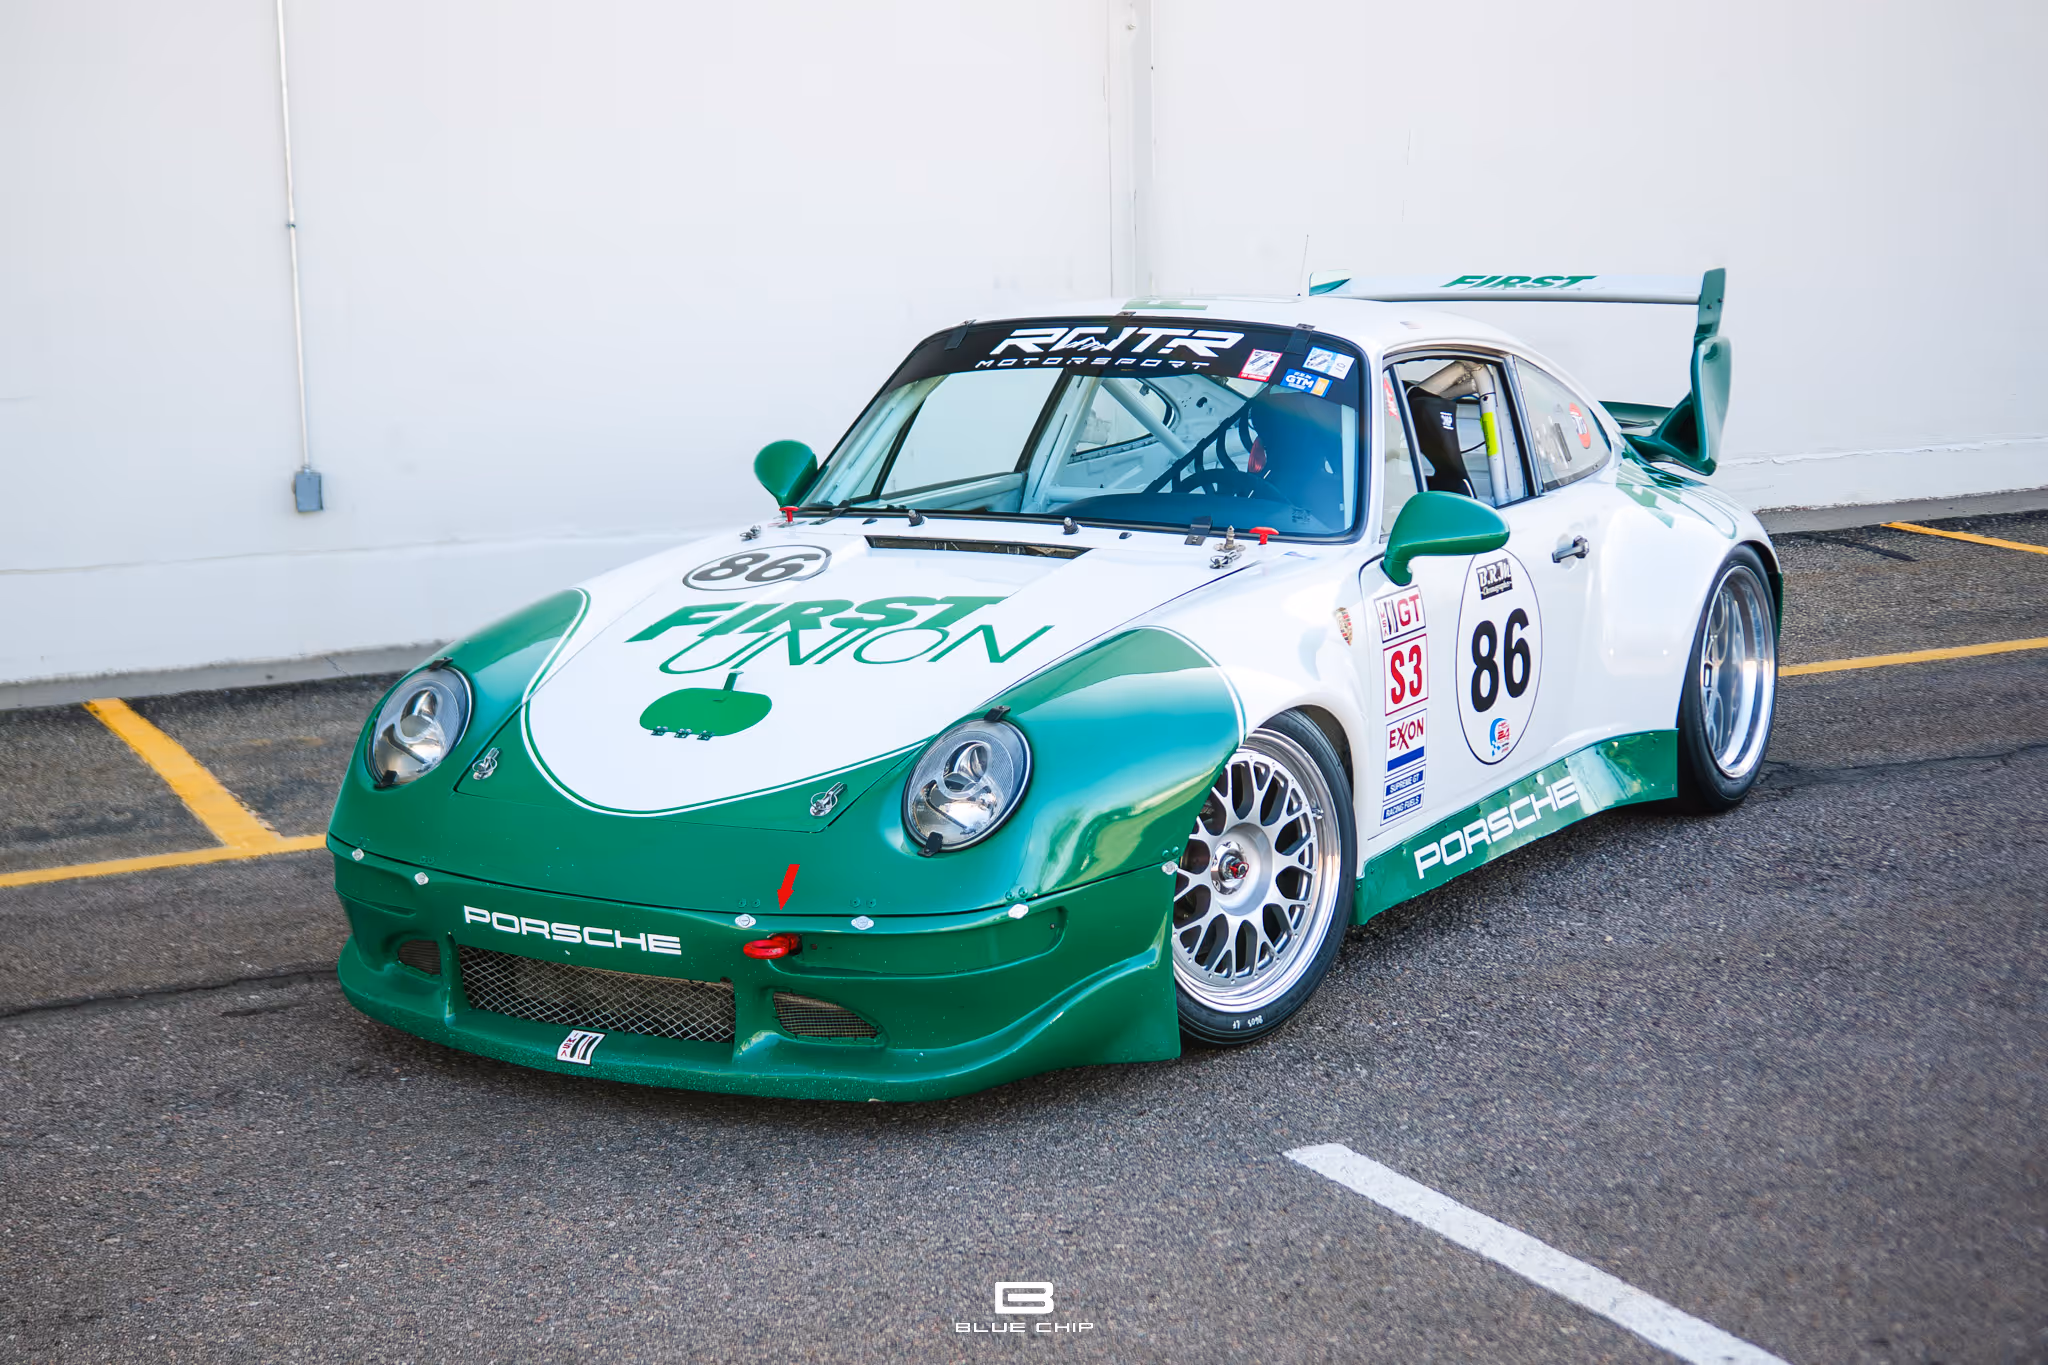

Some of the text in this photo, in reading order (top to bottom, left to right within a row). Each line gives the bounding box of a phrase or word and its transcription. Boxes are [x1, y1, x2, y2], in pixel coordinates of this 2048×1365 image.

[1440, 275, 1599, 289] FIRST
[975, 357, 1211, 369] MOTORSPORT
[1285, 374, 1315, 389] GTM
[692, 552, 821, 582] 86
[624, 595, 1009, 642] FIRST
[1397, 594, 1419, 627] GT
[659, 624, 1055, 675] UNION
[1471, 608, 1531, 713] 86
[1390, 644, 1422, 705] S3
[1389, 717, 1424, 750] EXXON
[1389, 776, 1412, 794] SUPREME
[1386, 796, 1419, 818] RACING FUELS
[1414, 775, 1580, 880] PORSCHE
[464, 905, 682, 956] PORSCHE
[561, 1032, 577, 1057] IMSA
